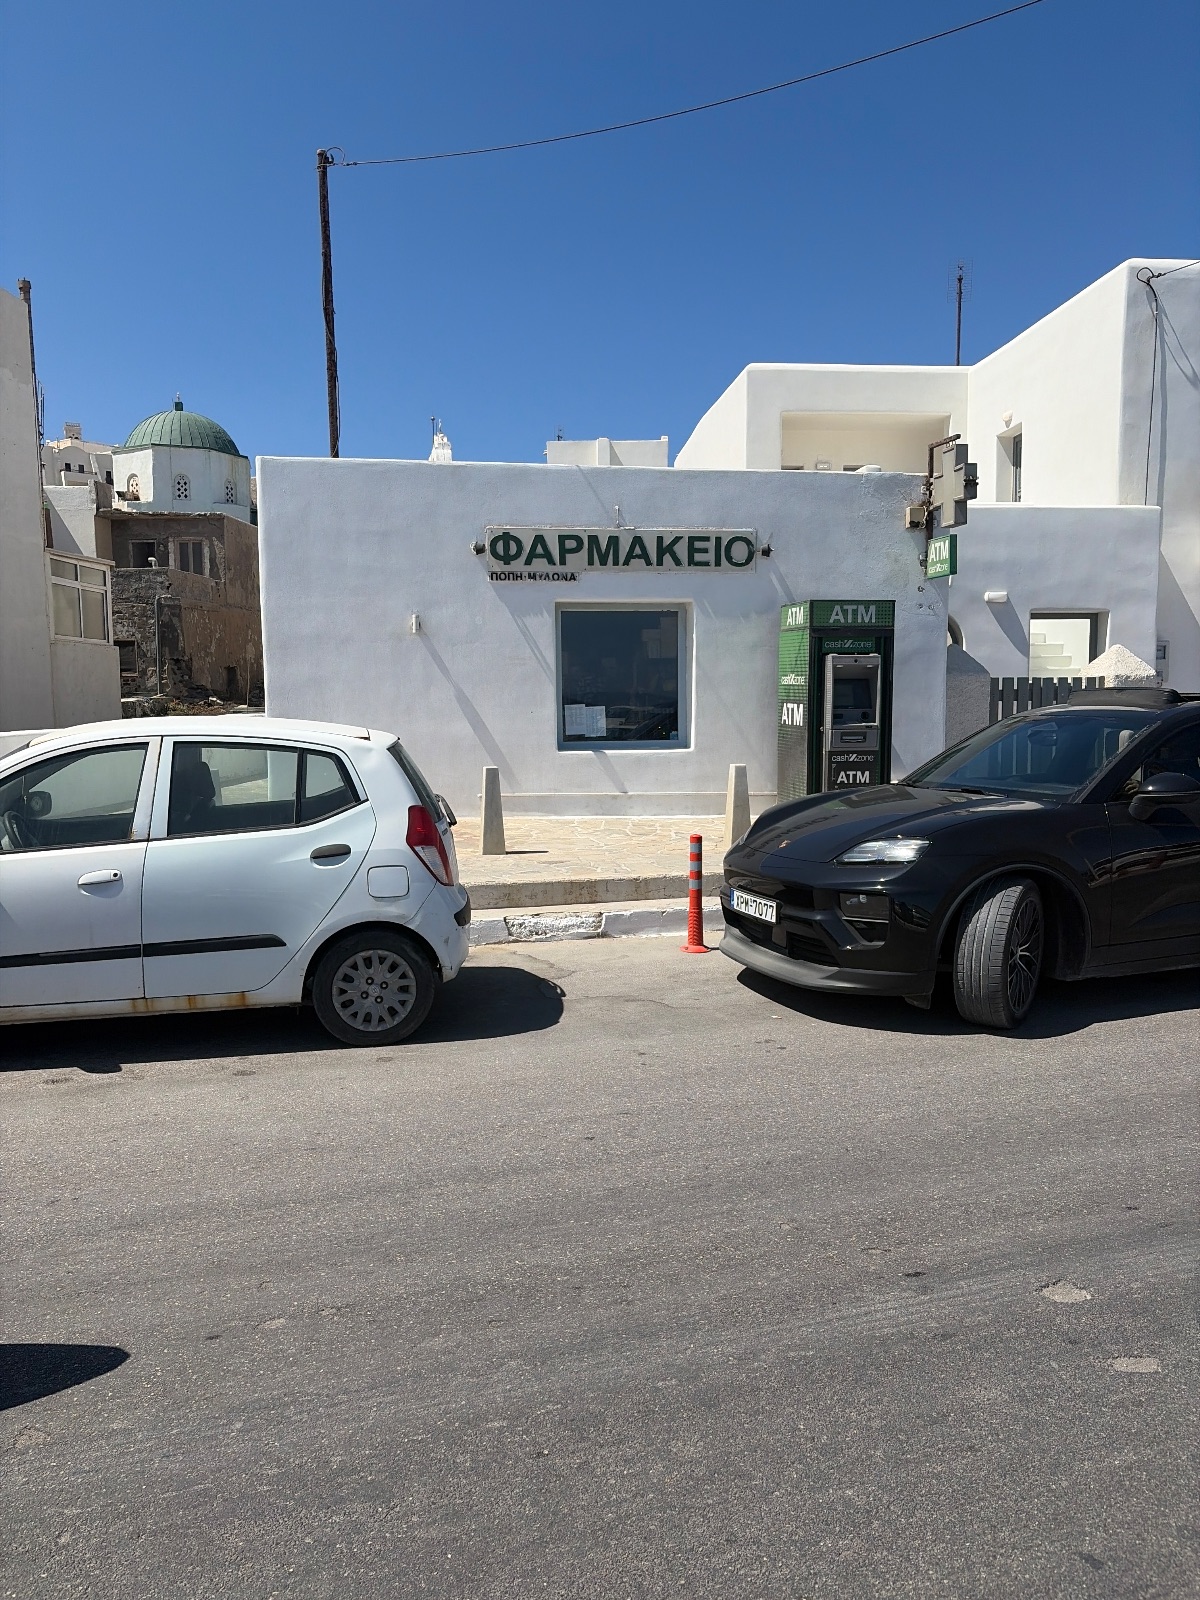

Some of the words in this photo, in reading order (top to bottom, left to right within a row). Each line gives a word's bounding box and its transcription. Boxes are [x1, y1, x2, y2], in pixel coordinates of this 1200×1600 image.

[489, 531, 755, 567] ΦΑΡΜΑΚΕΙΟ
[929, 540, 949, 562] ATM
[786, 606, 804, 626] ATM
[829, 604, 876, 623] ATM
[781, 702, 804, 727] ATM
[836, 770, 870, 784] ATM
